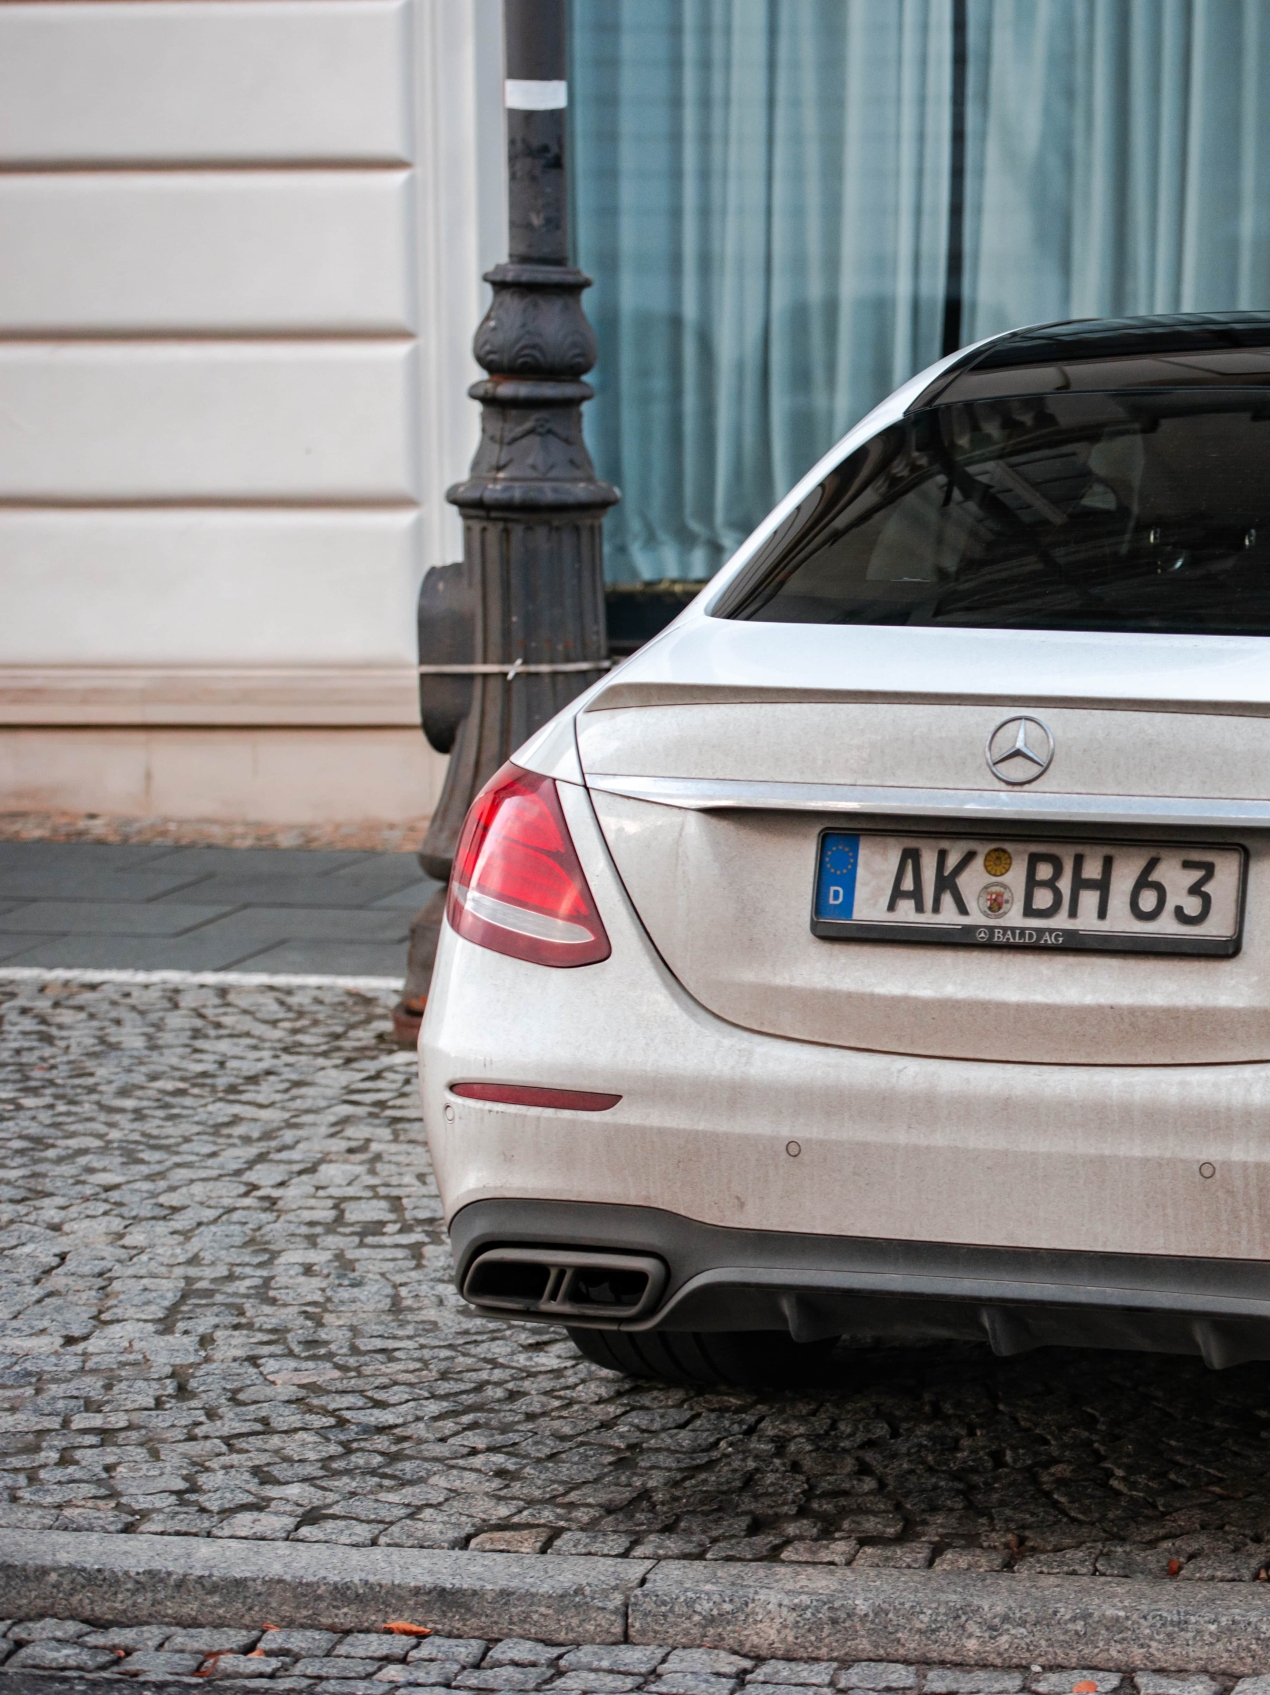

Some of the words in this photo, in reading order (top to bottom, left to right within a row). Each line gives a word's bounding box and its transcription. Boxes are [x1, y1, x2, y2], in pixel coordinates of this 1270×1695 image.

[828, 886, 844, 905] D
[886, 846, 978, 917] AK
[1022, 852, 1114, 920] BH
[1129, 856, 1216, 926] 63
[993, 929, 1036, 944] BALD
[1039, 931, 1064, 945] AG
